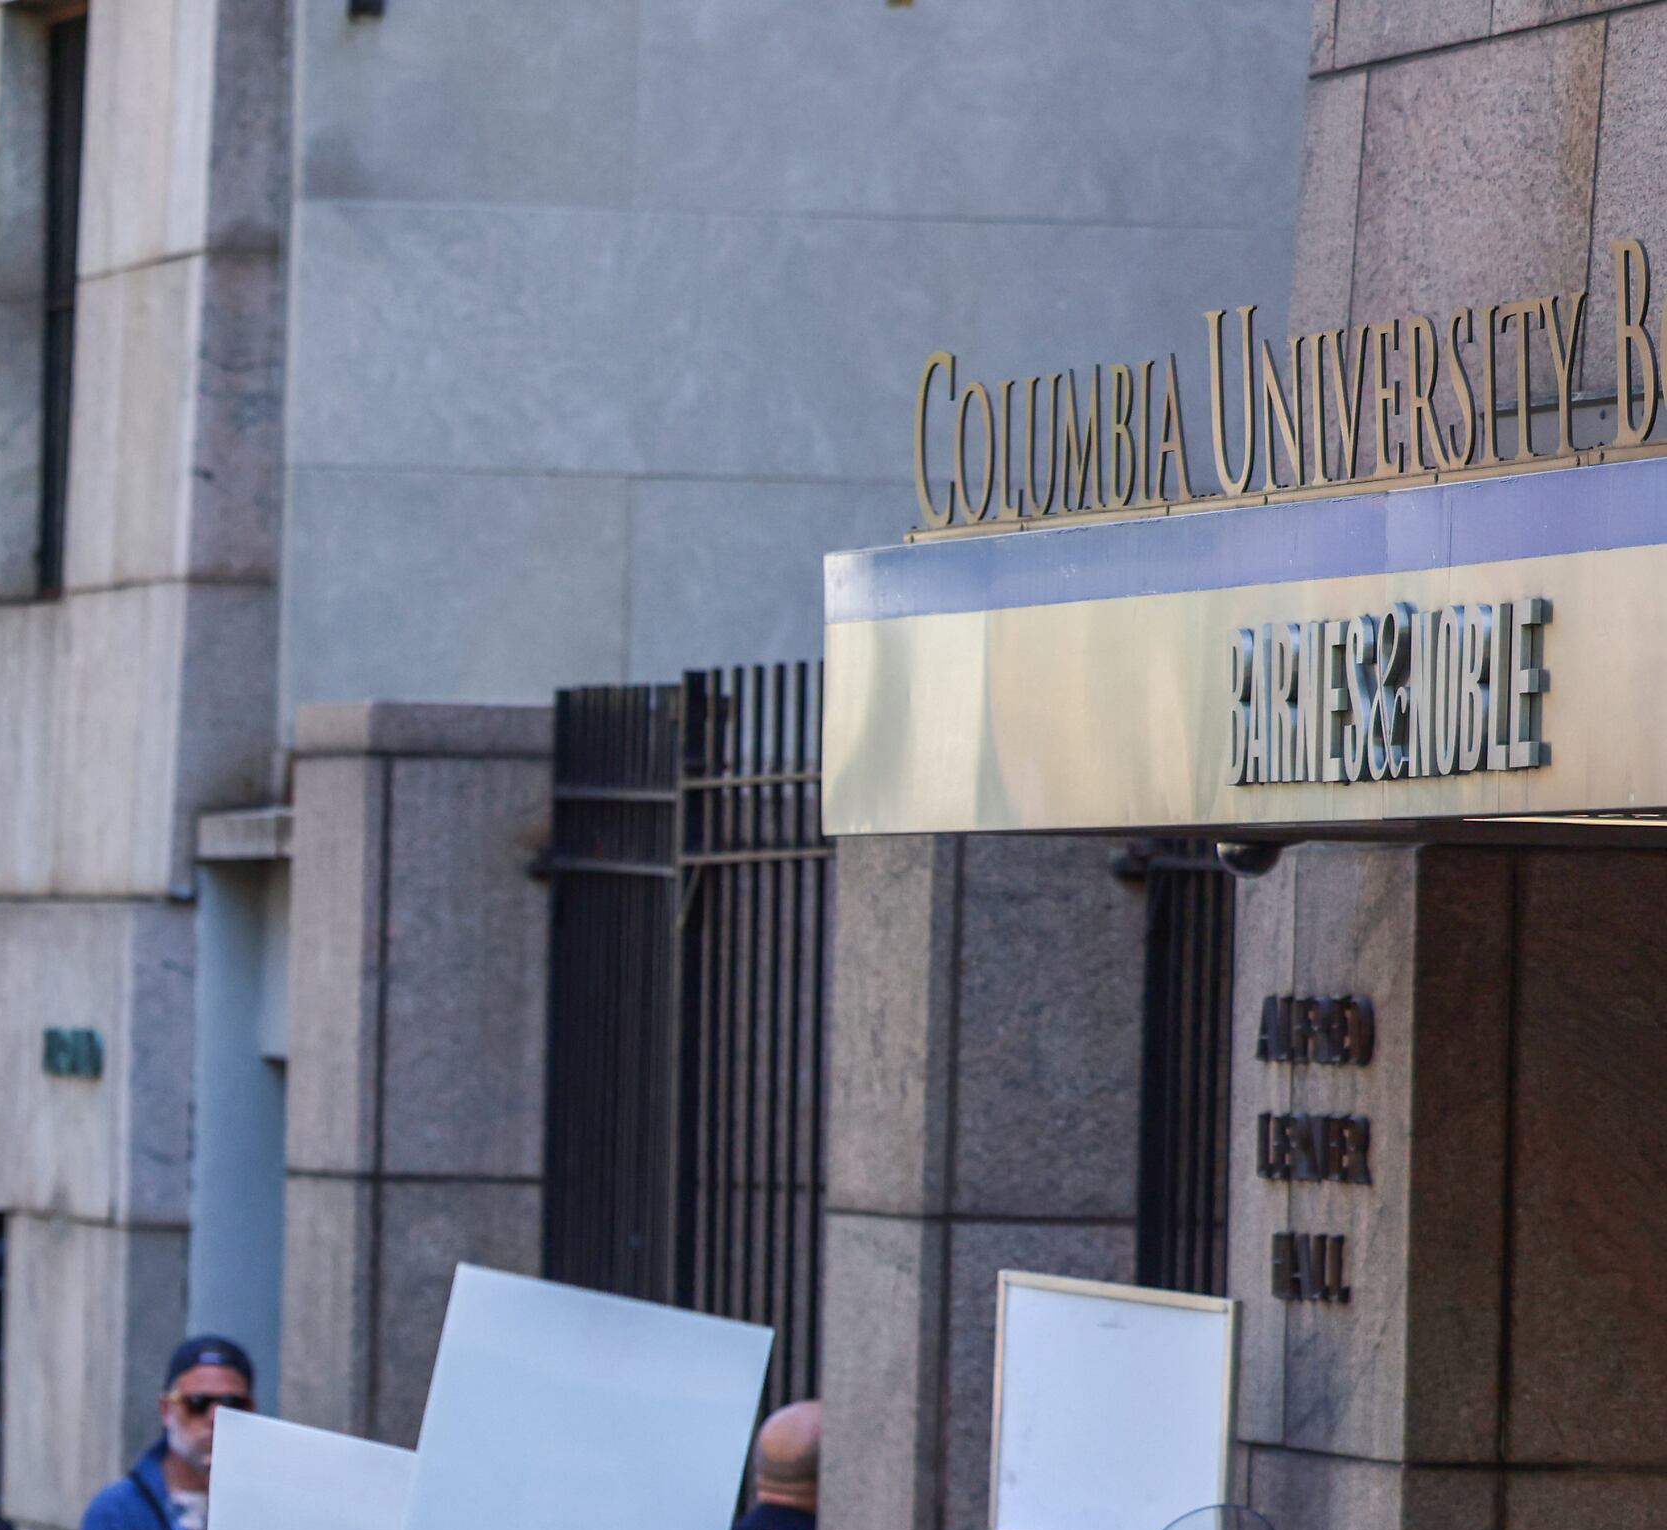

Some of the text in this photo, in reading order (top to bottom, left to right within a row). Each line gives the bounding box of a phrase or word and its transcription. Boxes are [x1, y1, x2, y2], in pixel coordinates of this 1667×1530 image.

[915, 239, 1667, 529] COLUMBIA UNIVERSITY B
